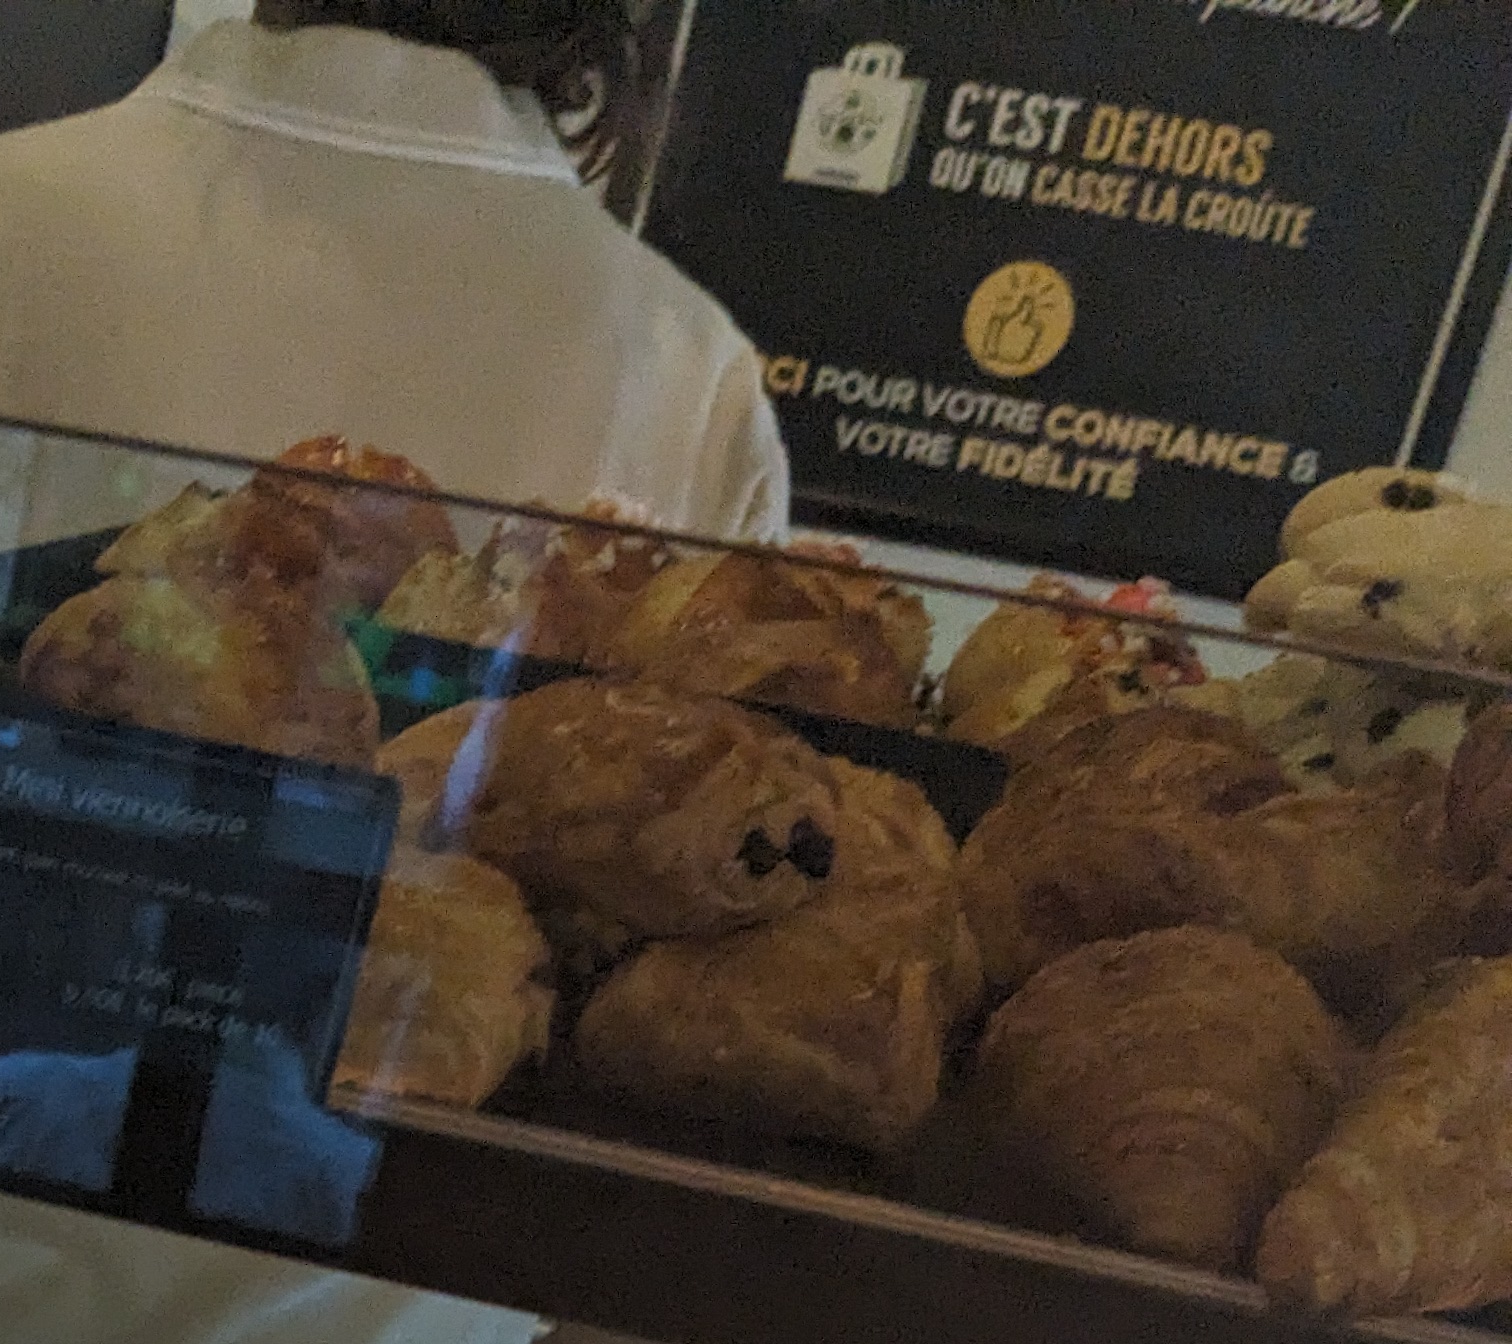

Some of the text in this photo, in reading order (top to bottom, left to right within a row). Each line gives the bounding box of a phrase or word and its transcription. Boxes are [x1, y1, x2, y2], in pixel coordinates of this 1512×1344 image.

[945, 82, 1272, 186] C'EST DEHORS
[1032, 164, 1135, 219] CASSE
[1135, 185, 1179, 226] LA
[1183, 185, 1317, 250] CROÛTE
[811, 364, 918, 413] POUR
[921, 384, 1042, 435] VOTRE
[1044, 403, 1289, 480] CONFIANCE
[835, 415, 1139, 501] VOTRE FIDÉLITÉ
